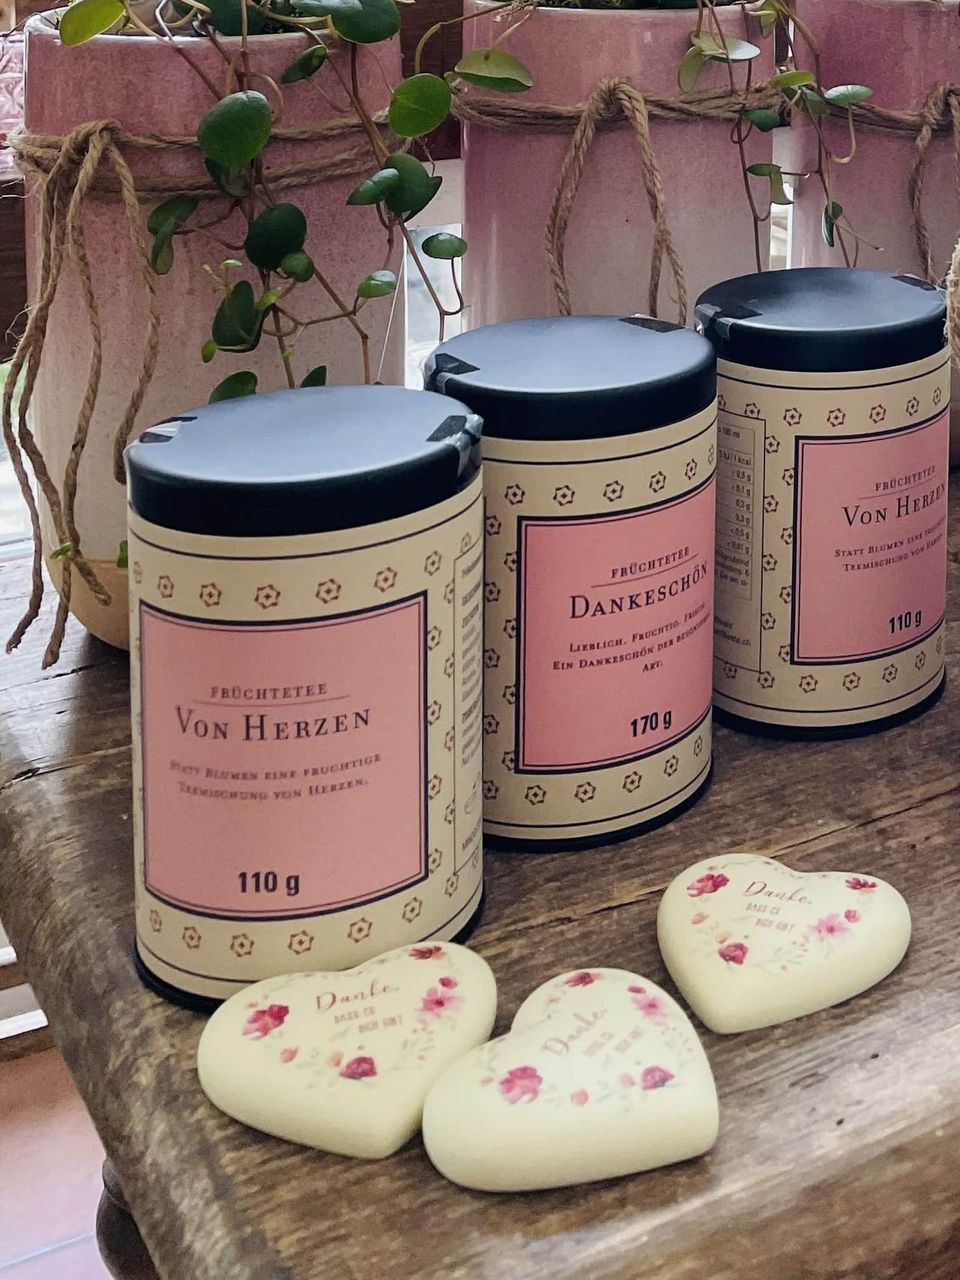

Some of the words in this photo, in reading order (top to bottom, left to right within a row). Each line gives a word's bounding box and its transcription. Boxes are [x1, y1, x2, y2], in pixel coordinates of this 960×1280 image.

[610, 546, 690, 579] FRÜCHTETEE
[888, 611, 912, 634] 110
[914, 610, 922, 628] g
[630, 710, 659, 738] 170
[662, 710, 672, 730] g
[238, 870, 279, 894] 110
[286, 874, 300, 897] g
